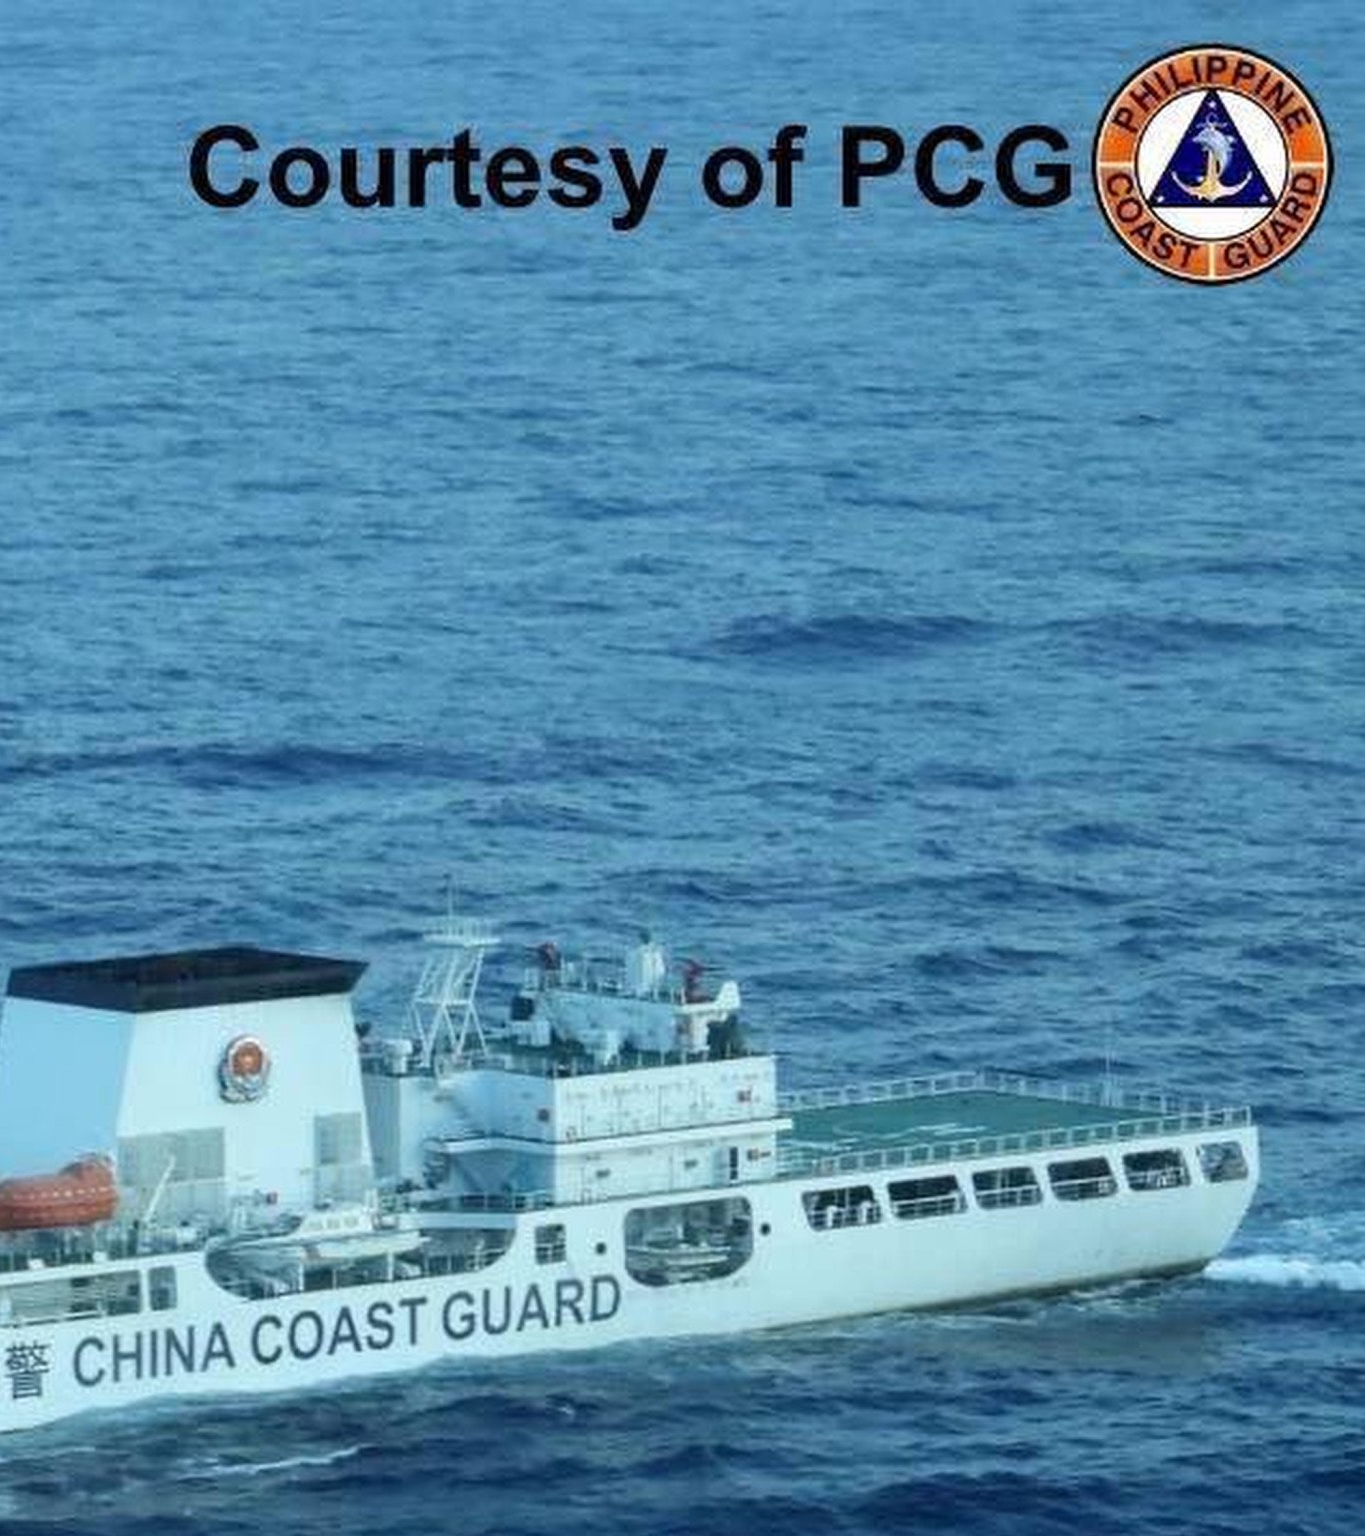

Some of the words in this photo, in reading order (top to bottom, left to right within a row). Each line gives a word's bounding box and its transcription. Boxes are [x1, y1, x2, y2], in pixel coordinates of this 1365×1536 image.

[73, 1321, 237, 1388] CHINA
[250, 1296, 428, 1365] COAST
[442, 1273, 621, 1341] GUARD
